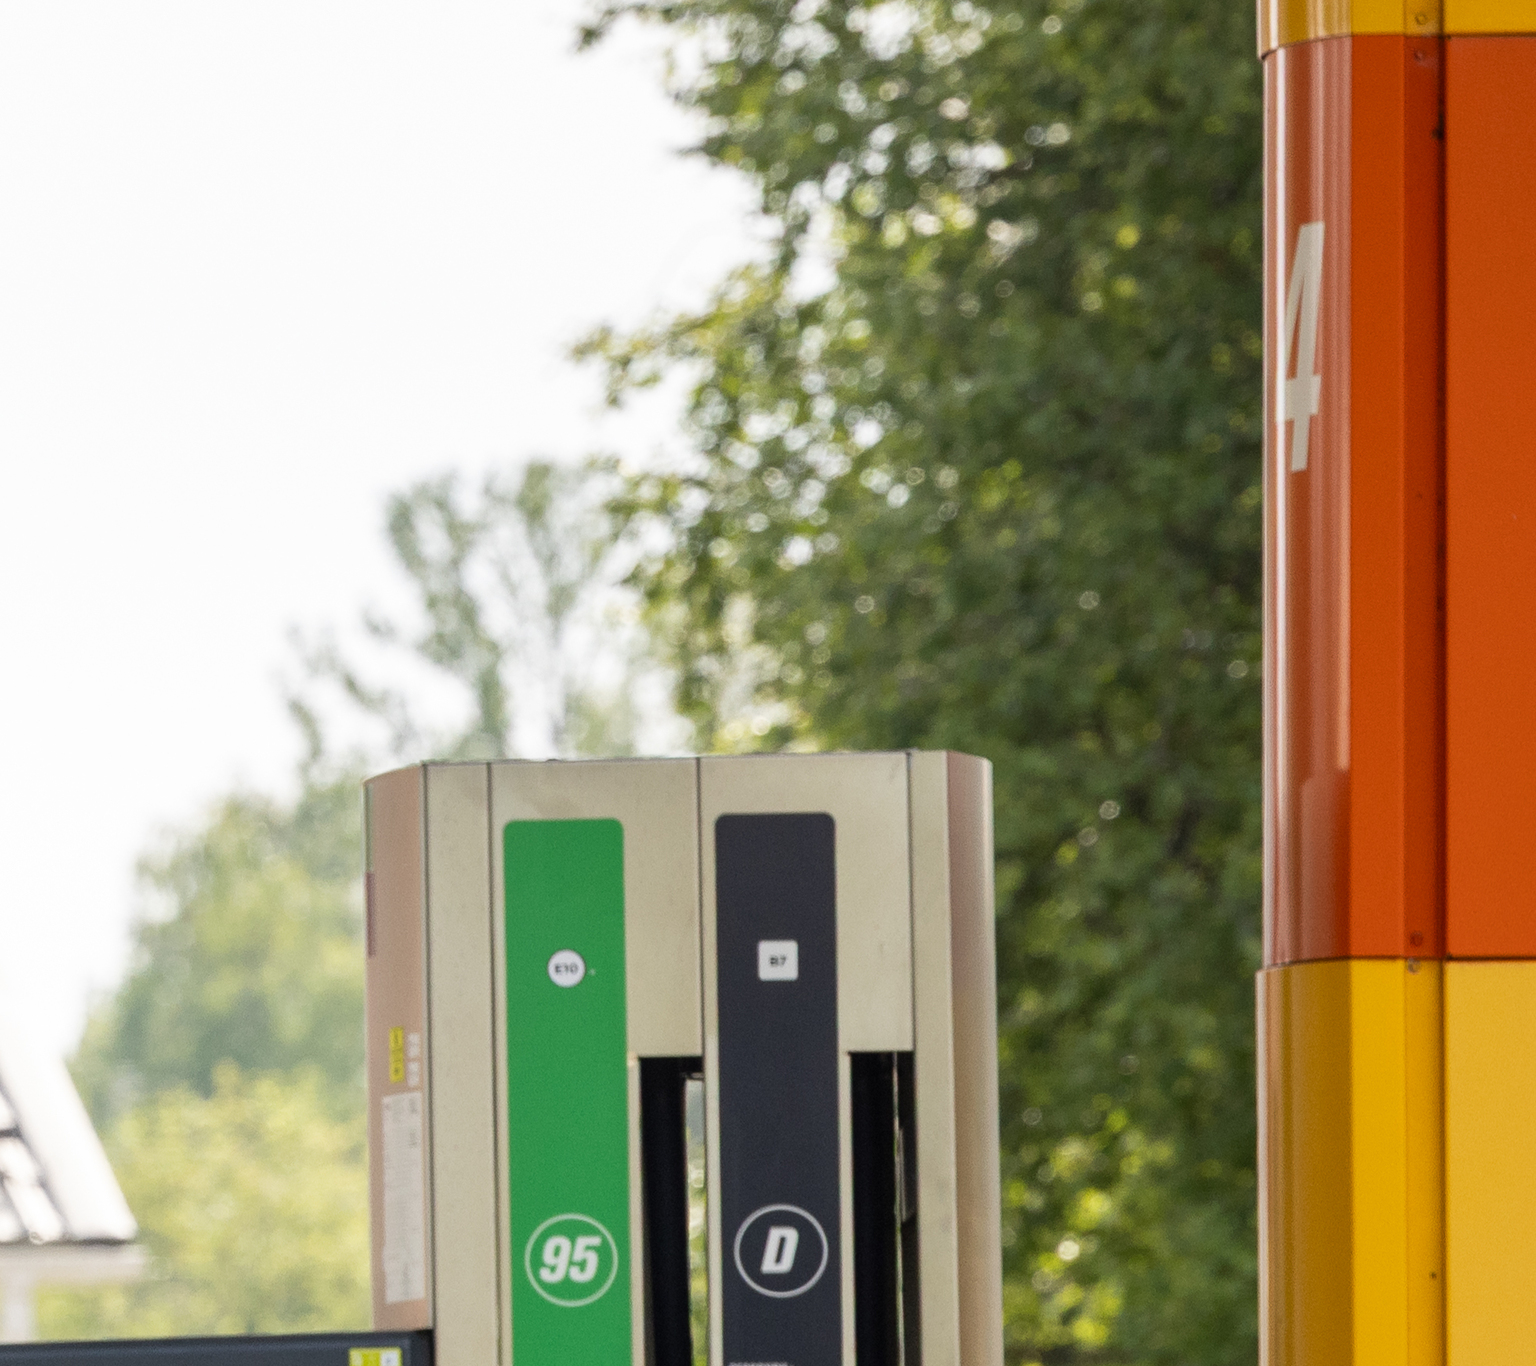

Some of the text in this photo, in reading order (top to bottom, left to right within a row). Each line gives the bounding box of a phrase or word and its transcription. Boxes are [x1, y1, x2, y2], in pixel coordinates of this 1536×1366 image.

[1275, 221, 1325, 473] 4
[554, 963, 579, 975] E10
[769, 955, 787, 967] B7
[539, 1235, 602, 1283] 95
[760, 1225, 799, 1275] D
